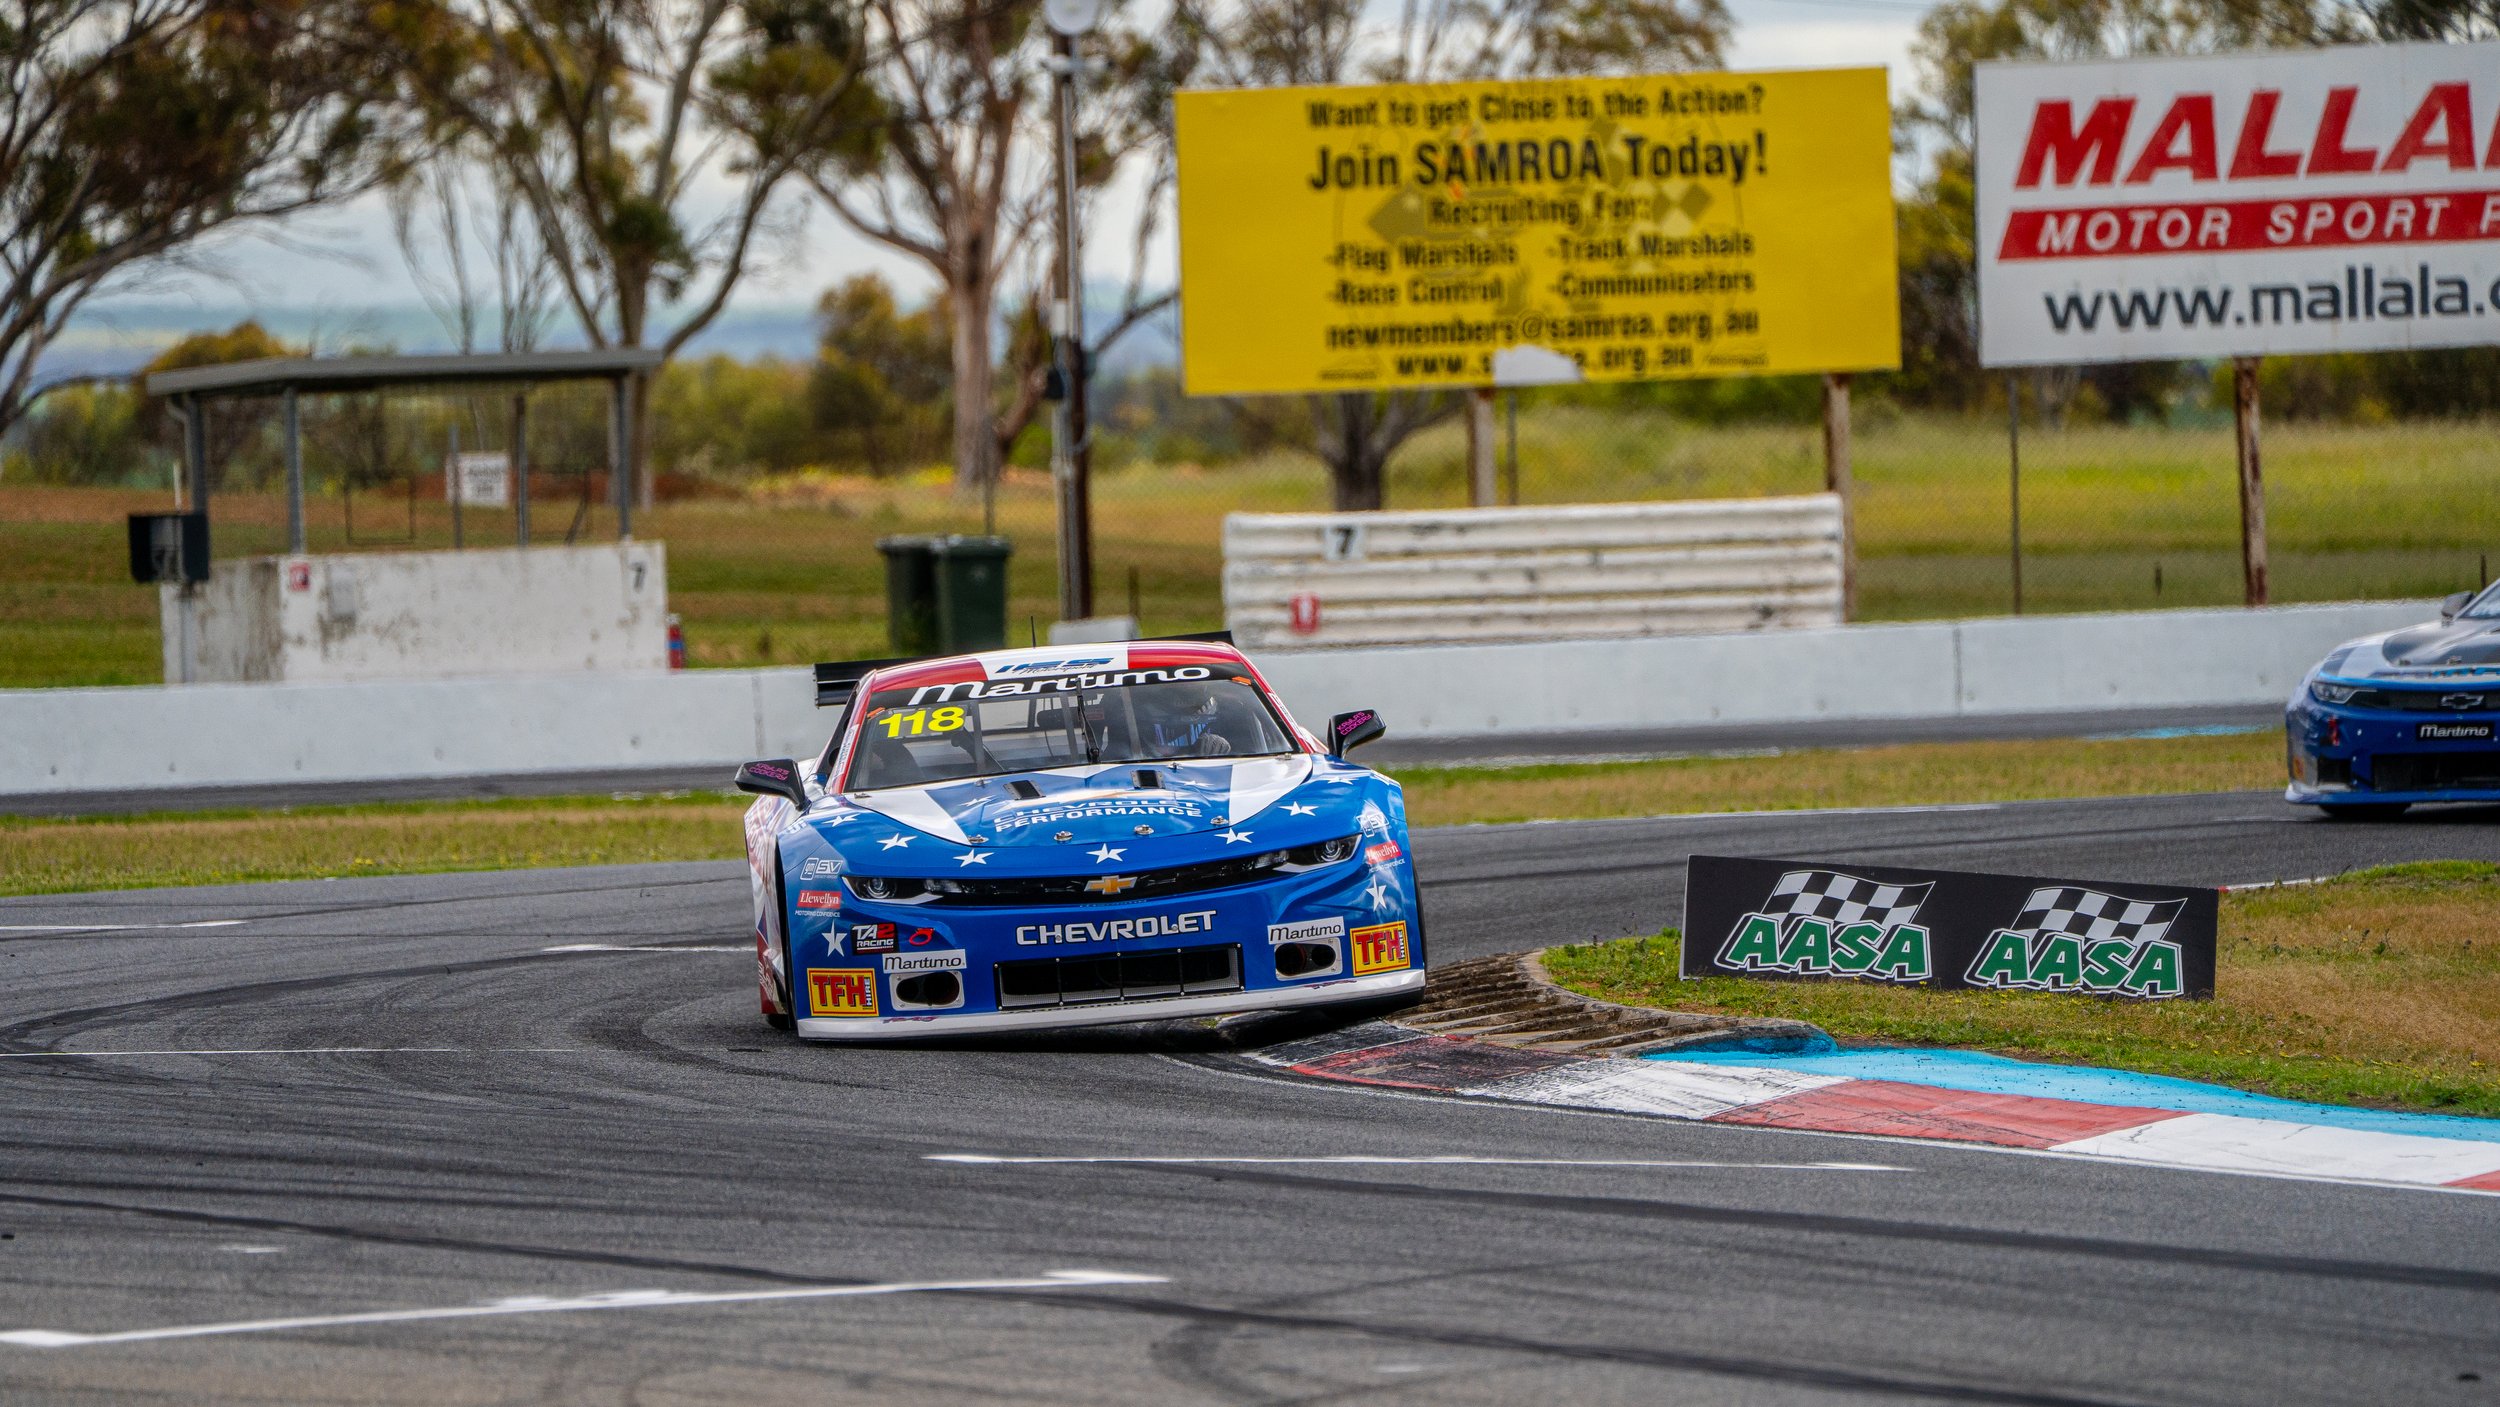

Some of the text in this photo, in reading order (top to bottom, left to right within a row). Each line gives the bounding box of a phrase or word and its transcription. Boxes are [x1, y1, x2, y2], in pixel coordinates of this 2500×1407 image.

[1308, 82, 1765, 130] Want to get Close to the Action?
[2014, 80, 2500, 191] MALLA
[1309, 129, 1768, 190] Join SAMROA Today!
[1428, 191, 1651, 226] Recruiting For:
[2036, 207, 2233, 254] MOTOR
[2266, 198, 2450, 245] SPORT
[1402, 239, 1519, 267] Marshals
[1640, 227, 1756, 257] Marshals
[1408, 273, 1506, 304] Control
[1325, 308, 1759, 348] newmembers@samroa.org.au
[1332, 525, 1354, 556] 7
[630, 561, 648, 592] 7
[878, 706, 965, 738] 118
[2419, 724, 2489, 738] Maritimo
[993, 799, 1201, 826] CHEVROLET
[995, 806, 1203, 833] PERFORMANCE
[816, 860, 843, 874] SV
[800, 891, 840, 907] Llewellyn
[852, 923, 895, 940] TA2
[856, 938, 894, 948] RACING
[1016, 910, 1217, 945] CHEVROLET
[1269, 923, 1342, 942] Maritimo
[1355, 928, 1402, 966] TFH
[1716, 912, 1932, 979] AASA
[883, 955, 963, 970] Maritimo
[1967, 929, 2183, 998] AASA
[812, 975, 868, 1008] TFH
